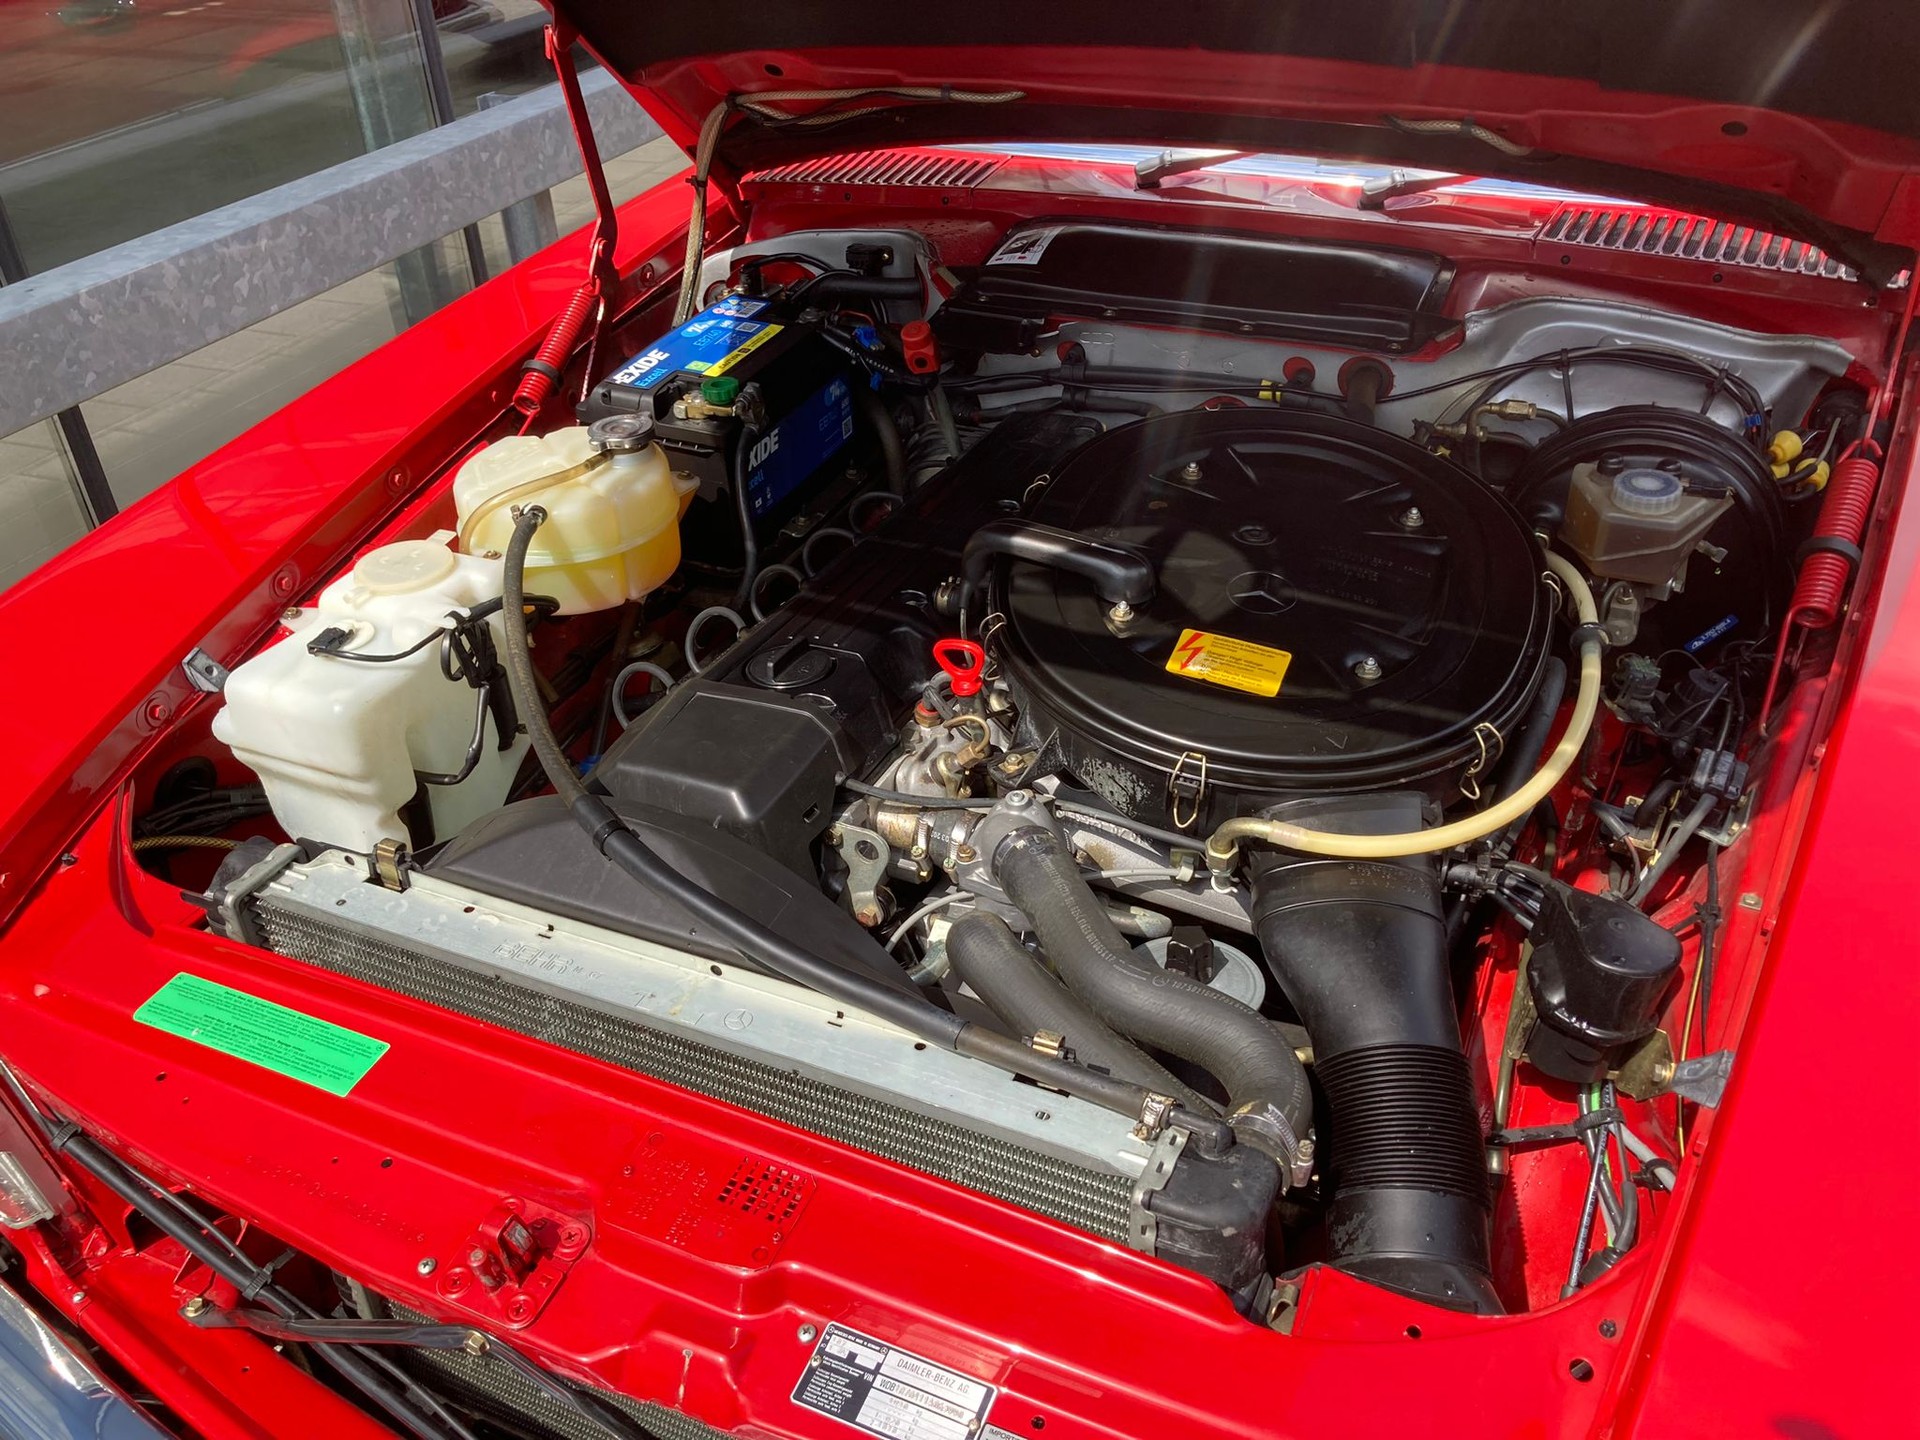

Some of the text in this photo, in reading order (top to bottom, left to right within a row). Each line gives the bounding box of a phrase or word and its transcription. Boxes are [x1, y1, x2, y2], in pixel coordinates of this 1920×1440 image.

[613, 348, 670, 384] EXIDE
[634, 368, 669, 387] Excell
[748, 427, 780, 471] XIDE
[863, 1372, 875, 1383] VIN
[896, 1358, 970, 1394] DAIMLER-BENZ AG
